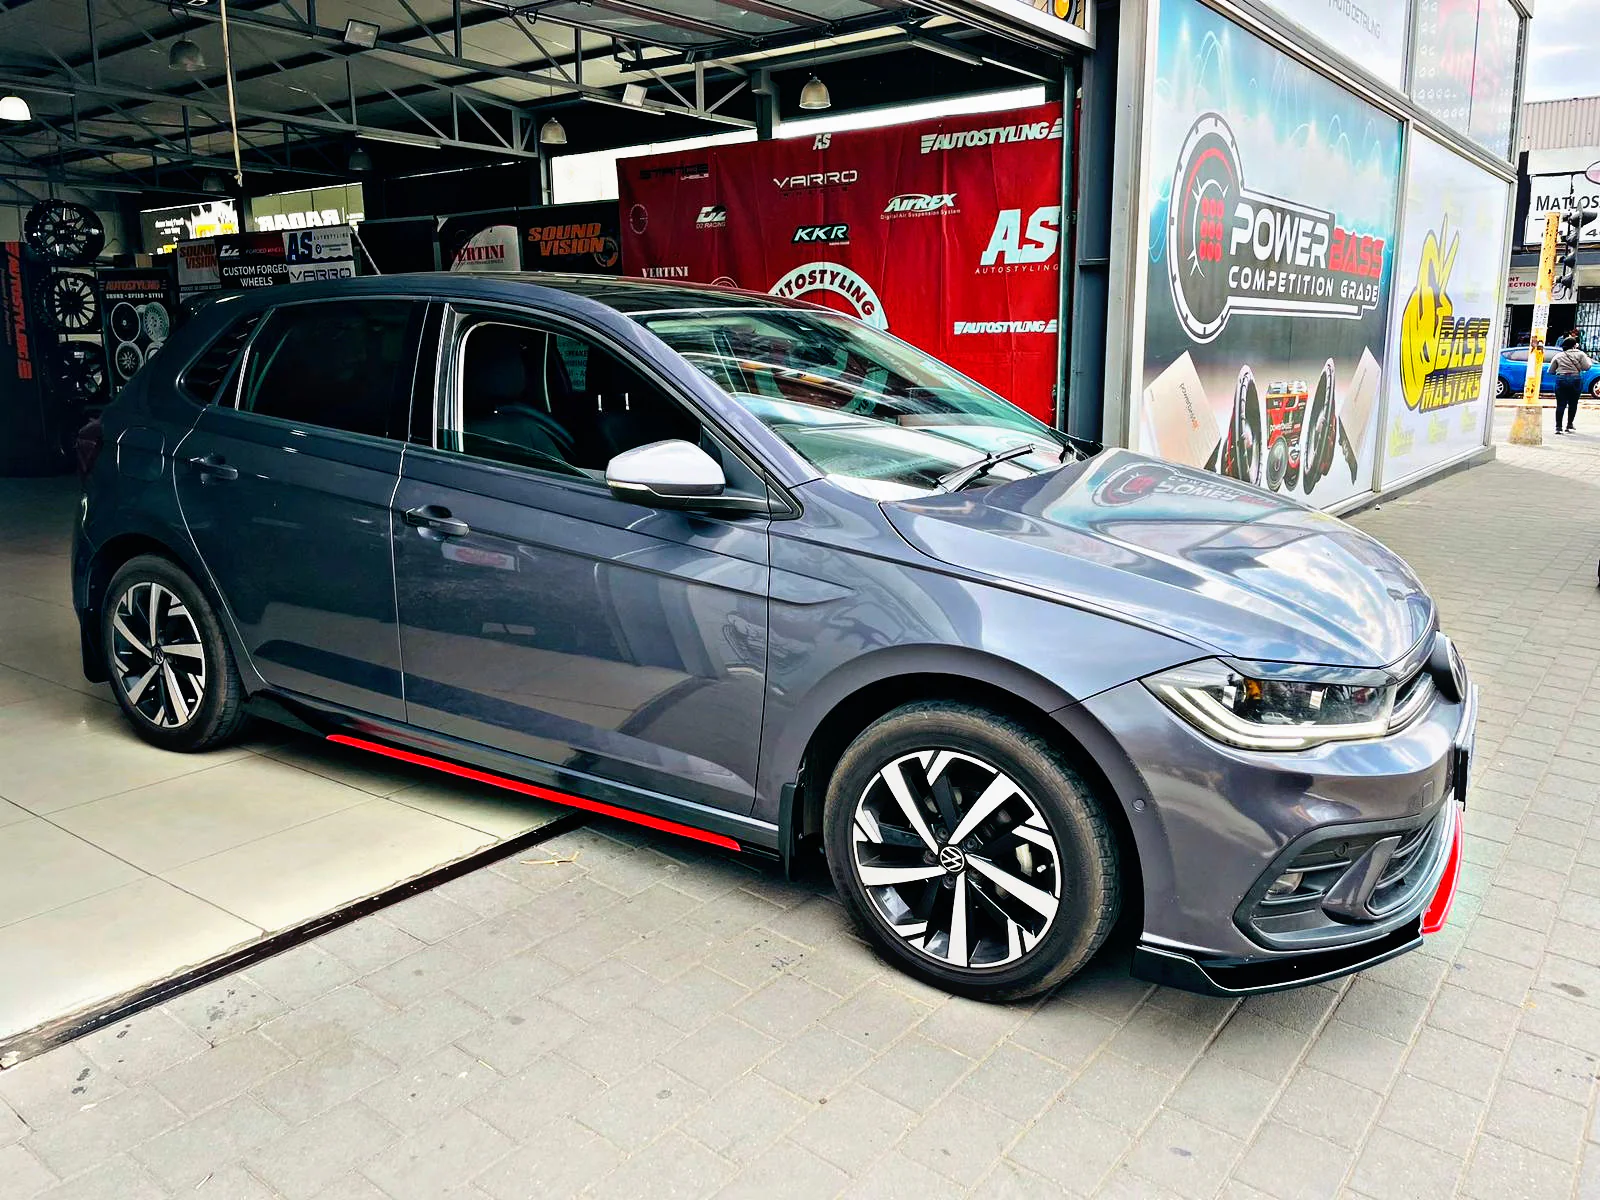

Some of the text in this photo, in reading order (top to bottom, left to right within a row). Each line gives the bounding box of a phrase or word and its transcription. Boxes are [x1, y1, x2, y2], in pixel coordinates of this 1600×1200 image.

[813, 133, 832, 150] AS
[932, 121, 1050, 151] AUTOSTYLING
[773, 170, 858, 189] VARRO
[1536, 195, 1600, 211] MATLOS
[528, 223, 602, 242] SOUND
[794, 225, 847, 241] KKR
[980, 205, 1061, 266] AS
[539, 238, 605, 257] VISION
[223, 264, 289, 276] CUSTOM FORGED
[642, 266, 689, 278] VERTINI
[975, 264, 1059, 275] AUTOSTYLING
[240, 277, 274, 287] WHEELS
[1228, 265, 1379, 302] COMPETITION GRADE
[776, 269, 875, 316] UTOSTYLING
[964, 321, 1047, 335] AUTOSTYLING
[1436, 316, 1490, 370] BASS
[1421, 369, 1484, 410] MASTERS
